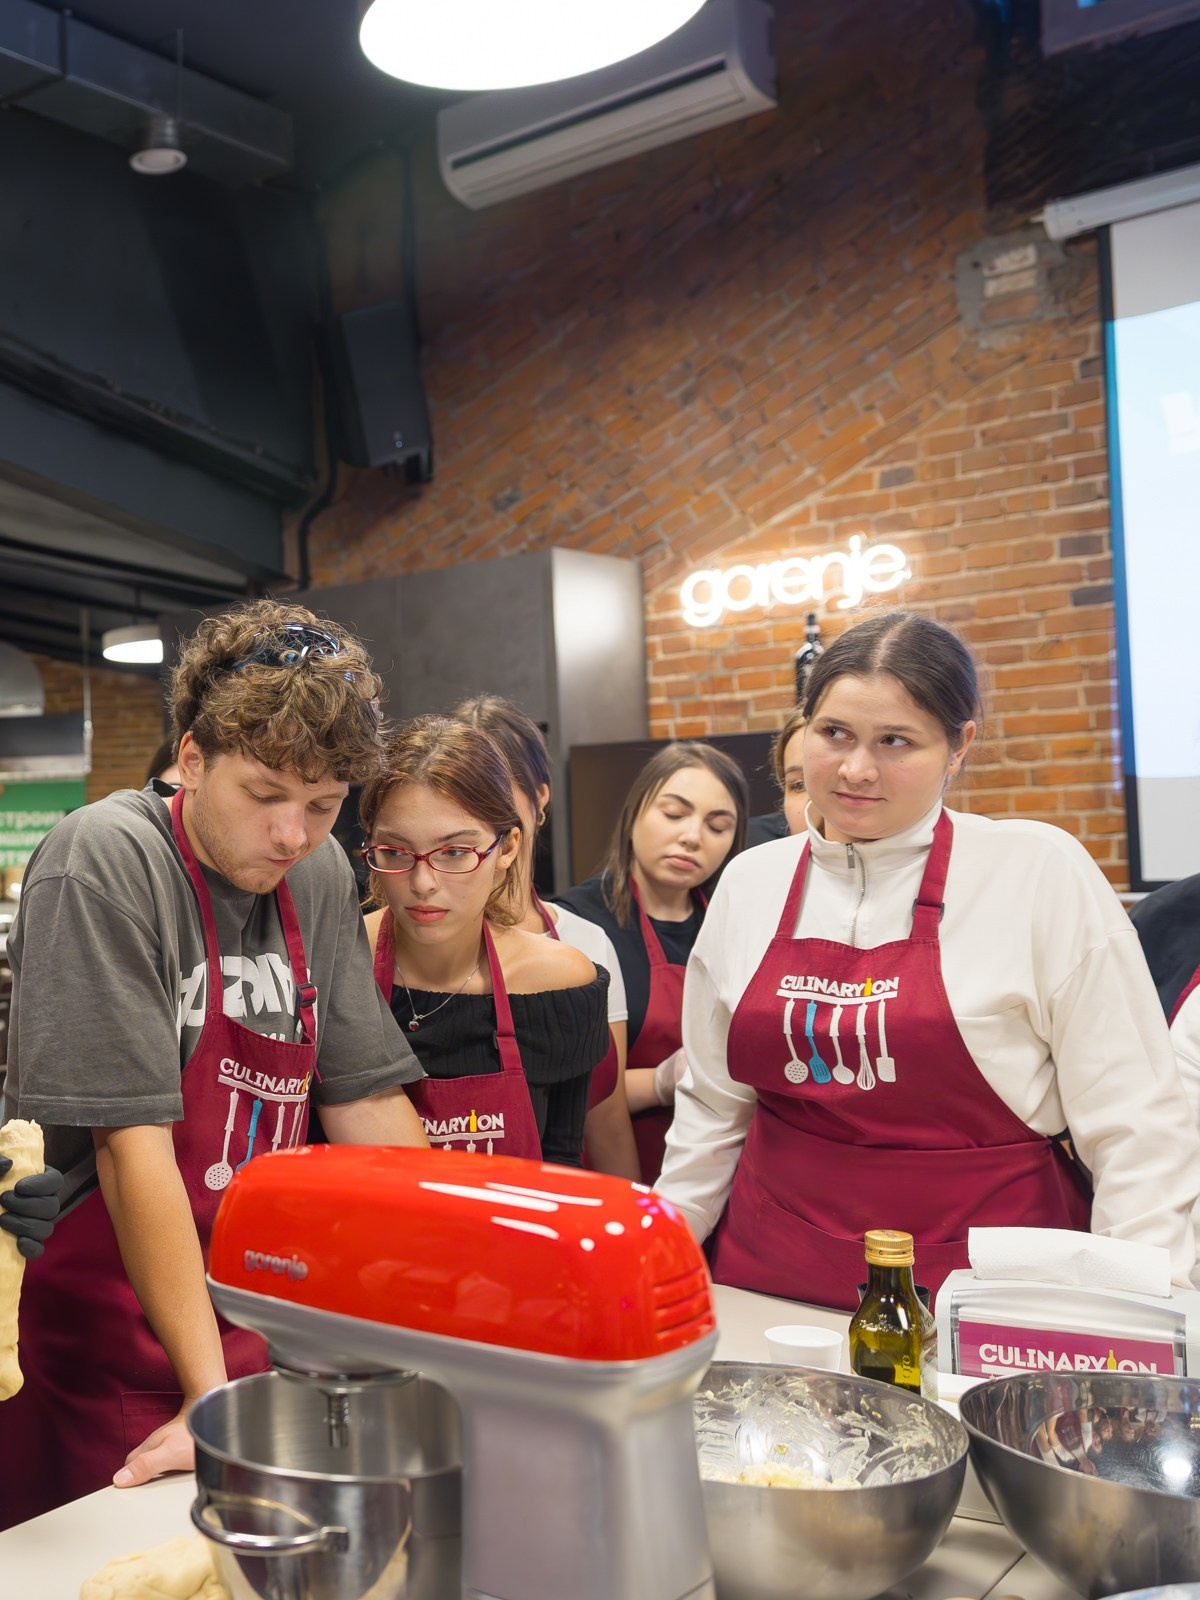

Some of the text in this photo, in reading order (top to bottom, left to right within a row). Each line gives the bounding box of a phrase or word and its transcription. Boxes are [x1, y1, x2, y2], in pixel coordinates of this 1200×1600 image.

[680, 535, 908, 627] gorenje
[219, 1057, 311, 1094] CULINARY
[243, 1249, 309, 1281] gorenje
